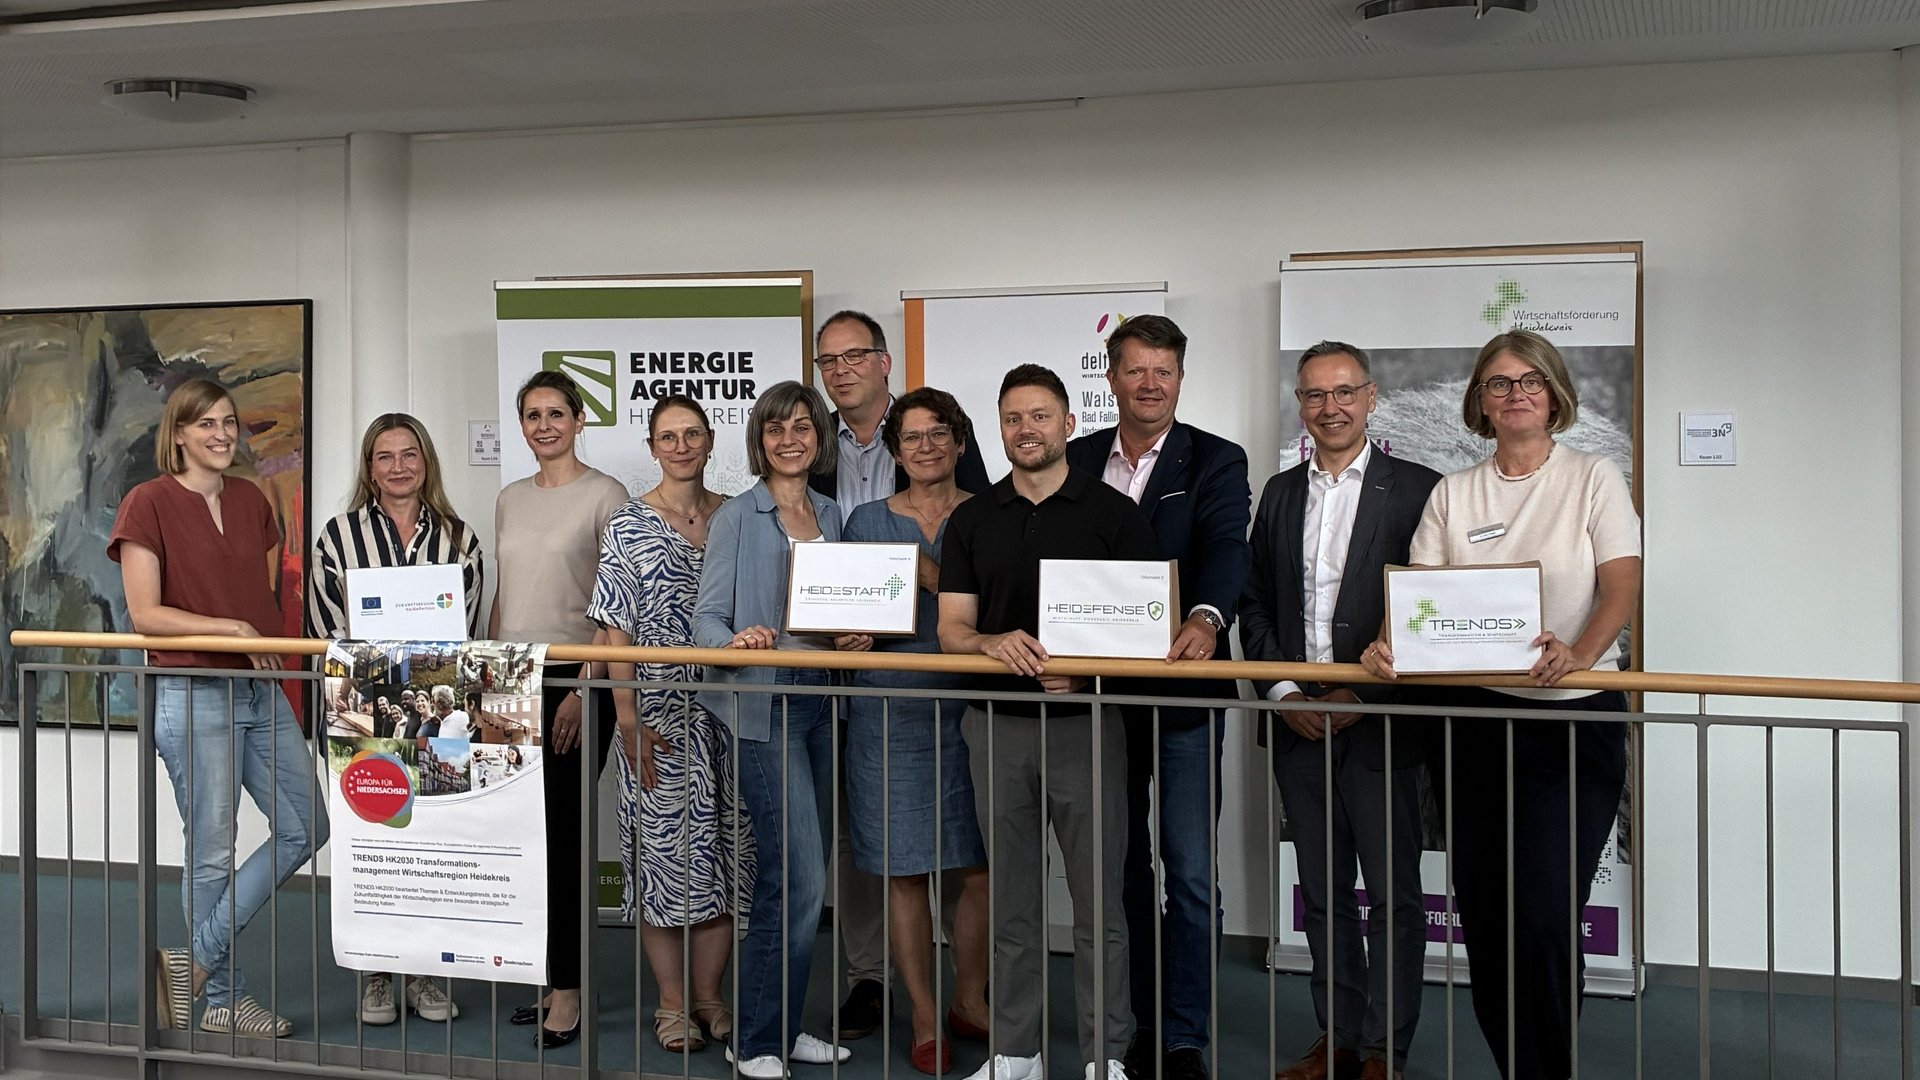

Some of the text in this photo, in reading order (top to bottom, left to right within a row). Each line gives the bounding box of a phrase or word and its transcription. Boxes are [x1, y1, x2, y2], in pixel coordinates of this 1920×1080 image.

[630, 352, 753, 374] ENERGIE
[1081, 352, 1107, 369] delt
[630, 379, 757, 400] AGENTUR
[1081, 391, 1115, 408] Wals
[1082, 411, 1119, 423] Bad Fallin
[356, 778, 394, 787] EUROPA FÜR
[356, 785, 408, 796] NIEDERSACHSEN
[352, 853, 481, 869] TRENDS HK2030 Transformations-
[352, 866, 511, 883] management Wirtschaftsregion Heidekreis
